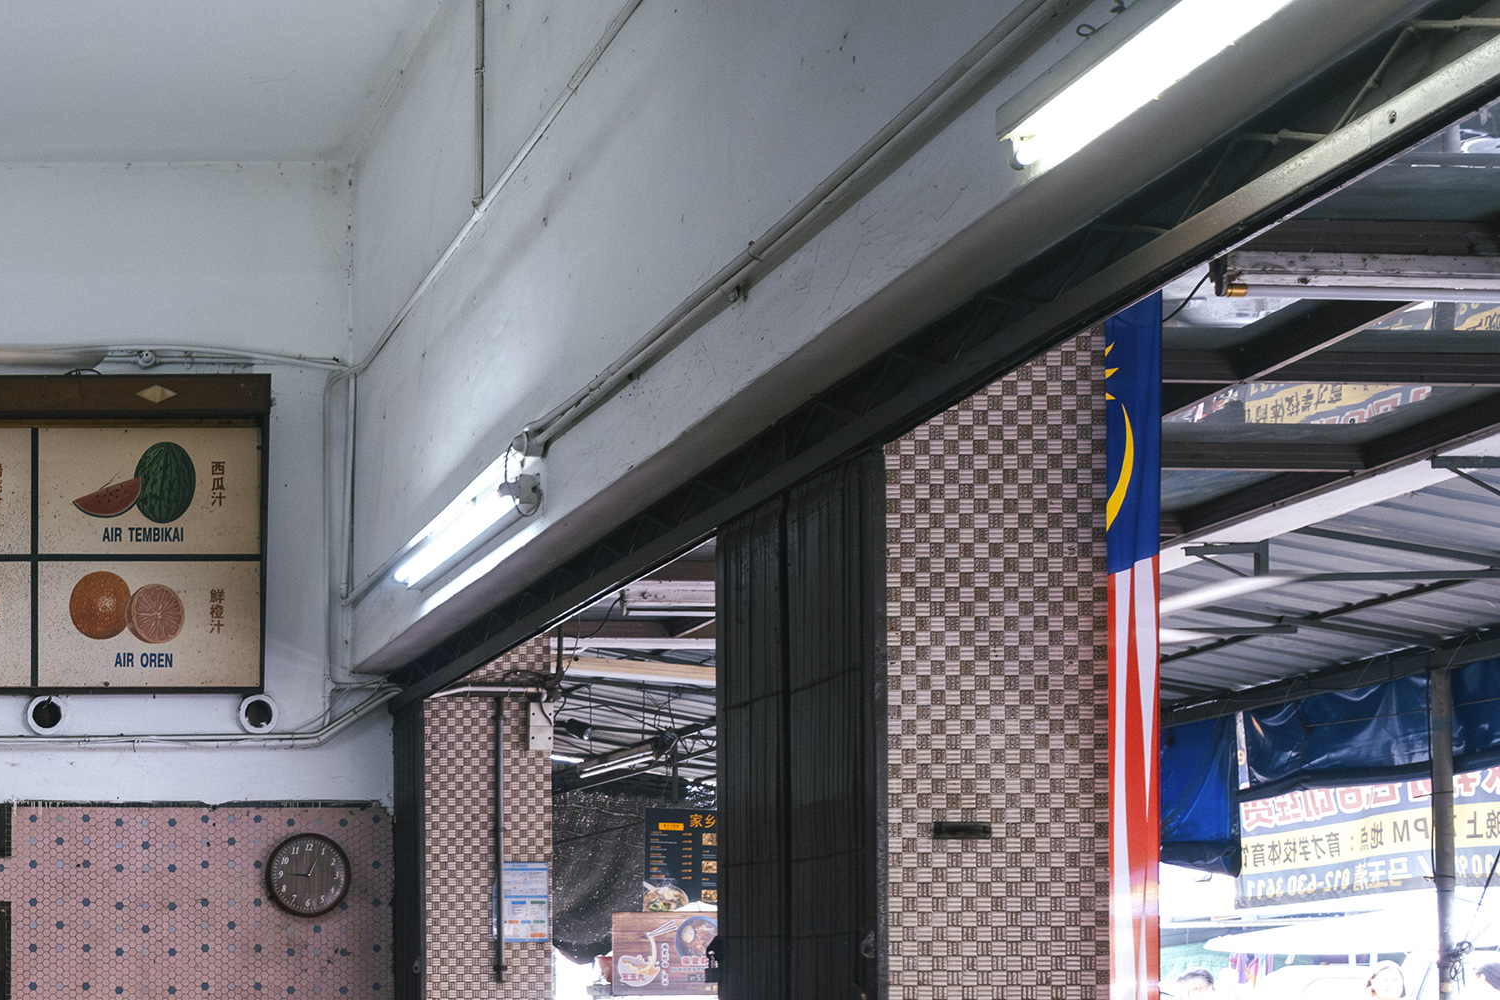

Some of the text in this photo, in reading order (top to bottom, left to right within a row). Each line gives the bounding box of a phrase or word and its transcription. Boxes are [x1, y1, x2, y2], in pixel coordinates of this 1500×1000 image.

[211, 461, 226, 506] 西瓜汁
[102, 527, 184, 542] AIR TEMBIKAI
[209, 589, 224, 634] 鮮橙汁
[114, 653, 173, 668] AIR OREN
[305, 843, 314, 851] 12
[321, 847, 325, 855] 1
[281, 857, 289, 865] 10
[334, 871, 339, 879] 3
[281, 884, 287, 892] 8
[330, 886, 335, 894] 4
[305, 899, 311, 907] 6
[320, 895, 325, 903] 5
